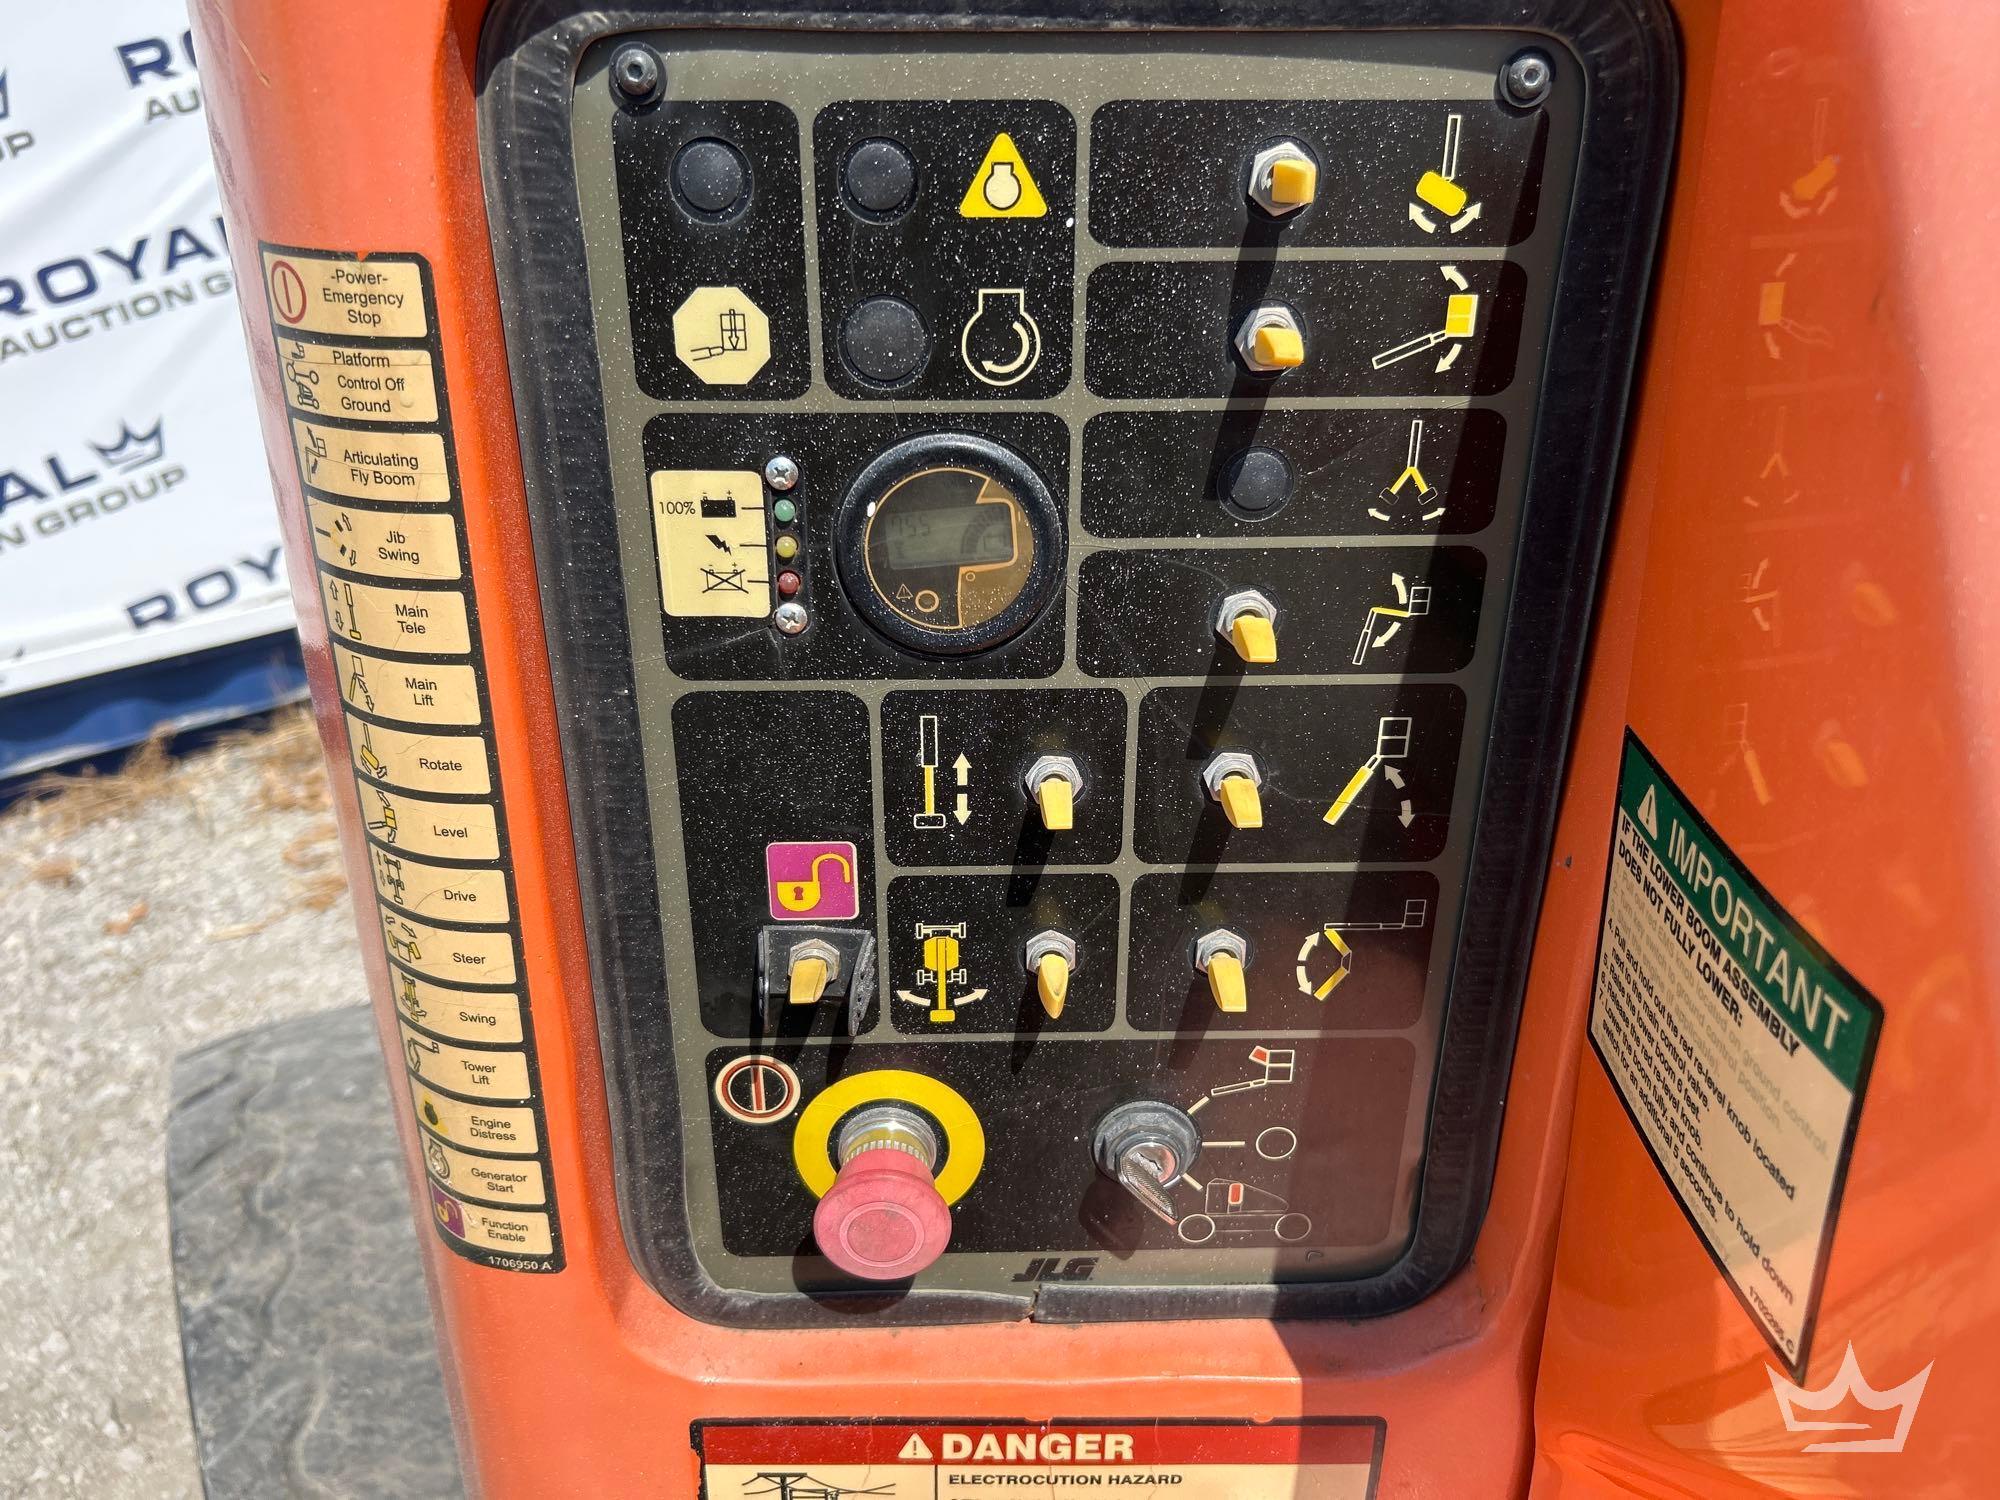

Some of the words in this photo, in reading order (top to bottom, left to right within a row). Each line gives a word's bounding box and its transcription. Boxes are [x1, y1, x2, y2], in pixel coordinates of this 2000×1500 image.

[115, 28, 198, 88] R
[323, 288, 404, 307] Emergency
[0, 281, 197, 361] AUCTION
[348, 310, 381, 326] Stop
[333, 350, 390, 368] Platform
[337, 375, 381, 391] Control
[385, 377, 405, 392] Off
[341, 397, 391, 413] Ground
[343, 450, 419, 470] Articulating
[351, 469, 369, 485] Fly
[374, 472, 415, 486] Boom
[33, 466, 187, 537] GROUP
[659, 501, 696, 516] 100%
[386, 531, 406, 544] Jib
[378, 548, 420, 564] Swing
[395, 604, 429, 618] Main
[397, 620, 426, 634] Tele
[405, 678, 437, 691] Main
[414, 695, 434, 706] Lift
[419, 758, 462, 771] Rotate
[433, 825, 468, 838] Level
[444, 889, 476, 902] Drive
[1619, 840, 1642, 884] DOES
[1643, 876, 1663, 913] NOT
[1664, 906, 1695, 959] FULLY
[1696, 952, 1742, 1026] LOWER:
[1622, 815, 1630, 834] IF
[1632, 828, 1649, 865] THE
[1650, 855, 1684, 915] LOWER
[1686, 906, 1721, 964] BOOM
[1722, 958, 1799, 1056] ASSEMBLY
[1667, 818, 1849, 1050] IMPORTANT
[452, 952, 486, 965] Steer
[459, 1012, 496, 1026] Swing
[1612, 947, 1624, 973] next
[1632, 980, 1642, 1003] the
[1643, 1000, 1659, 1032] main
[1660, 1029, 1686, 1074] control
[1688, 1070, 1709, 1111] valve.
[461, 1060, 496, 1073] Tower
[1614, 926, 1625, 952] Pull
[1626, 949, 1638, 973] and
[1639, 966, 1653, 998] hold
[1654, 995, 1665, 1018] out
[1667, 1012, 1678, 1037] the
[1680, 1035, 1693, 1060] red
[1694, 1057, 1725, 1108] re-level
[1727, 1102, 1751, 1143] knob
[1753, 1138, 1794, 1200] located
[472, 1074, 490, 1085] Lift
[471, 1116, 511, 1129] Engine
[1603, 1019, 1620, 1056] switch
[1639, 1087, 1672, 1148] additional
[1680, 1157, 1717, 1222] seconds.
[470, 1128, 516, 1141] Distress
[471, 1167, 527, 1183] Generator
[487, 1181, 514, 1193] Start
[481, 1217, 529, 1231] Function
[488, 1229, 526, 1243] Enable
[489, 1256, 539, 1270] 1706950
[541, 1260, 552, 1270] A
[1011, 1257, 1099, 1282] JLG
[942, 1433, 1134, 1461] DANGER
[949, 1474, 1102, 1485] ELECTROCUTION
[1108, 1474, 1183, 1485] HAZARD
